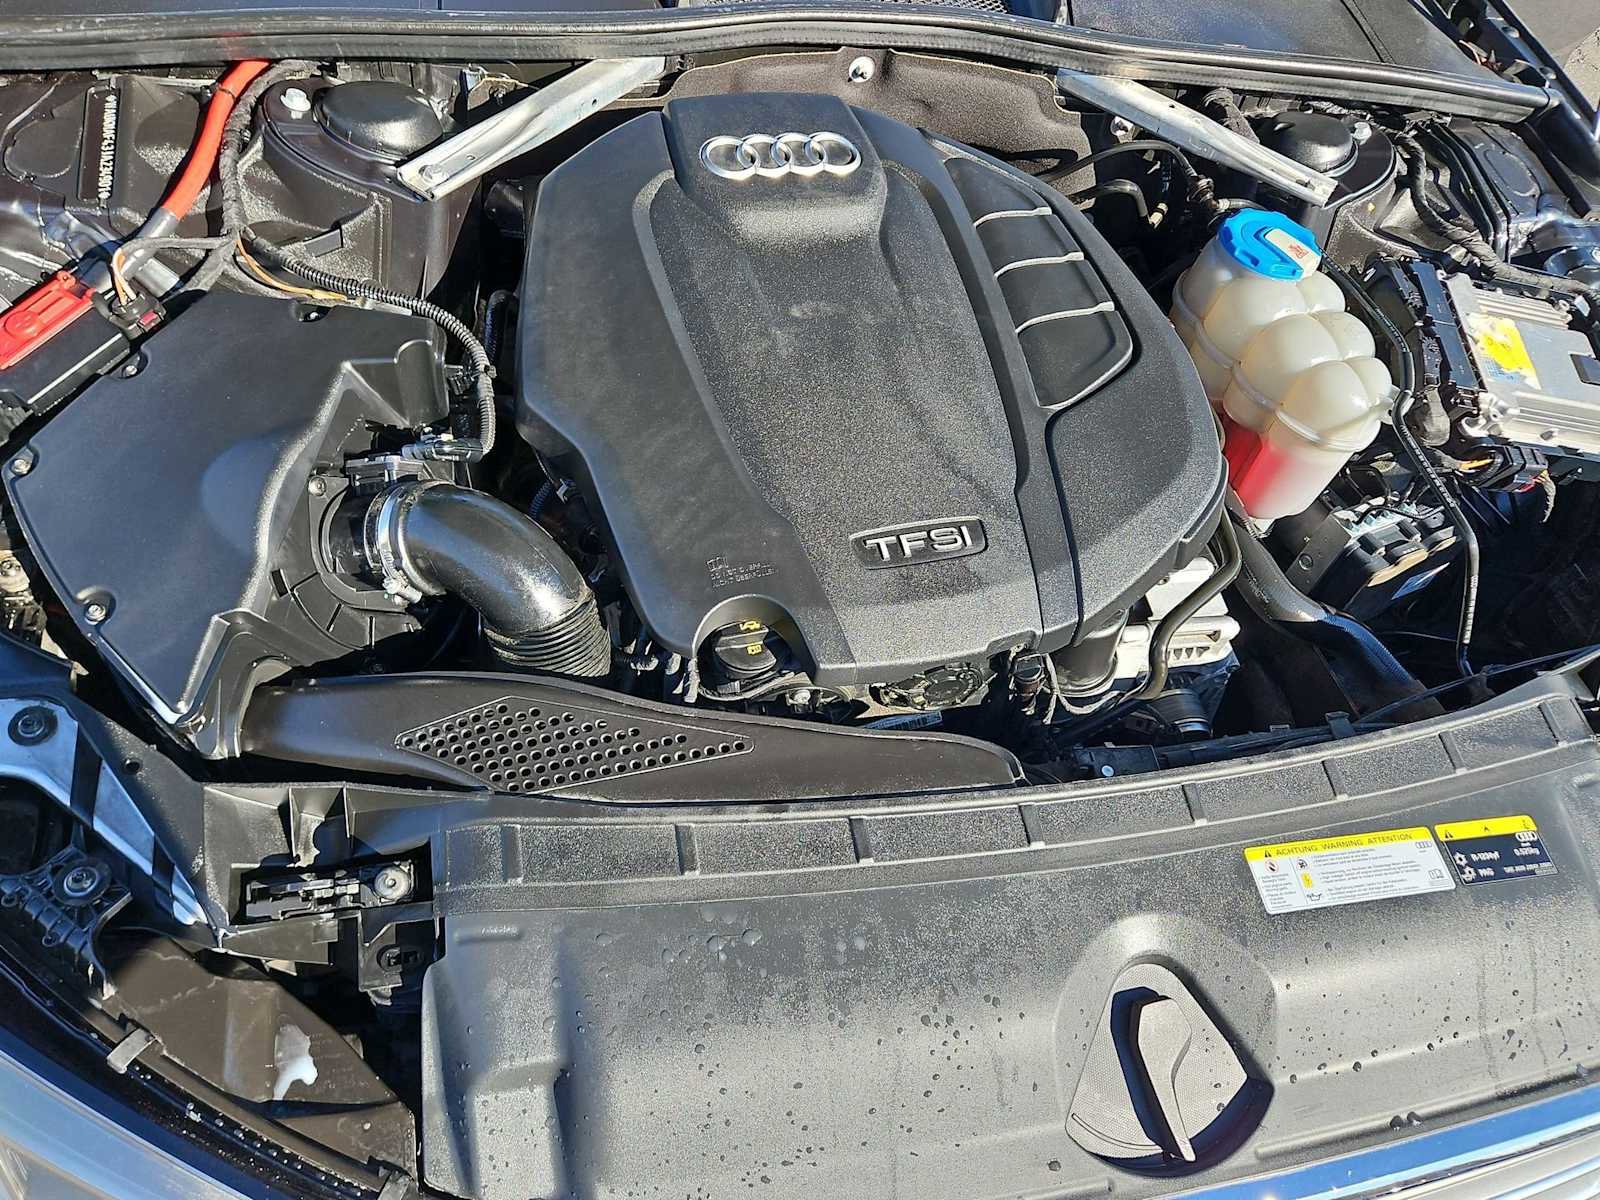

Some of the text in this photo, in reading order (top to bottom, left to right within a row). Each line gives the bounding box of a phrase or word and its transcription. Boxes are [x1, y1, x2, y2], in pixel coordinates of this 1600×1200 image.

[864, 525, 974, 561] TFSI
[1275, 833, 1413, 856] ACHTUNG WARNING ATTENTION
